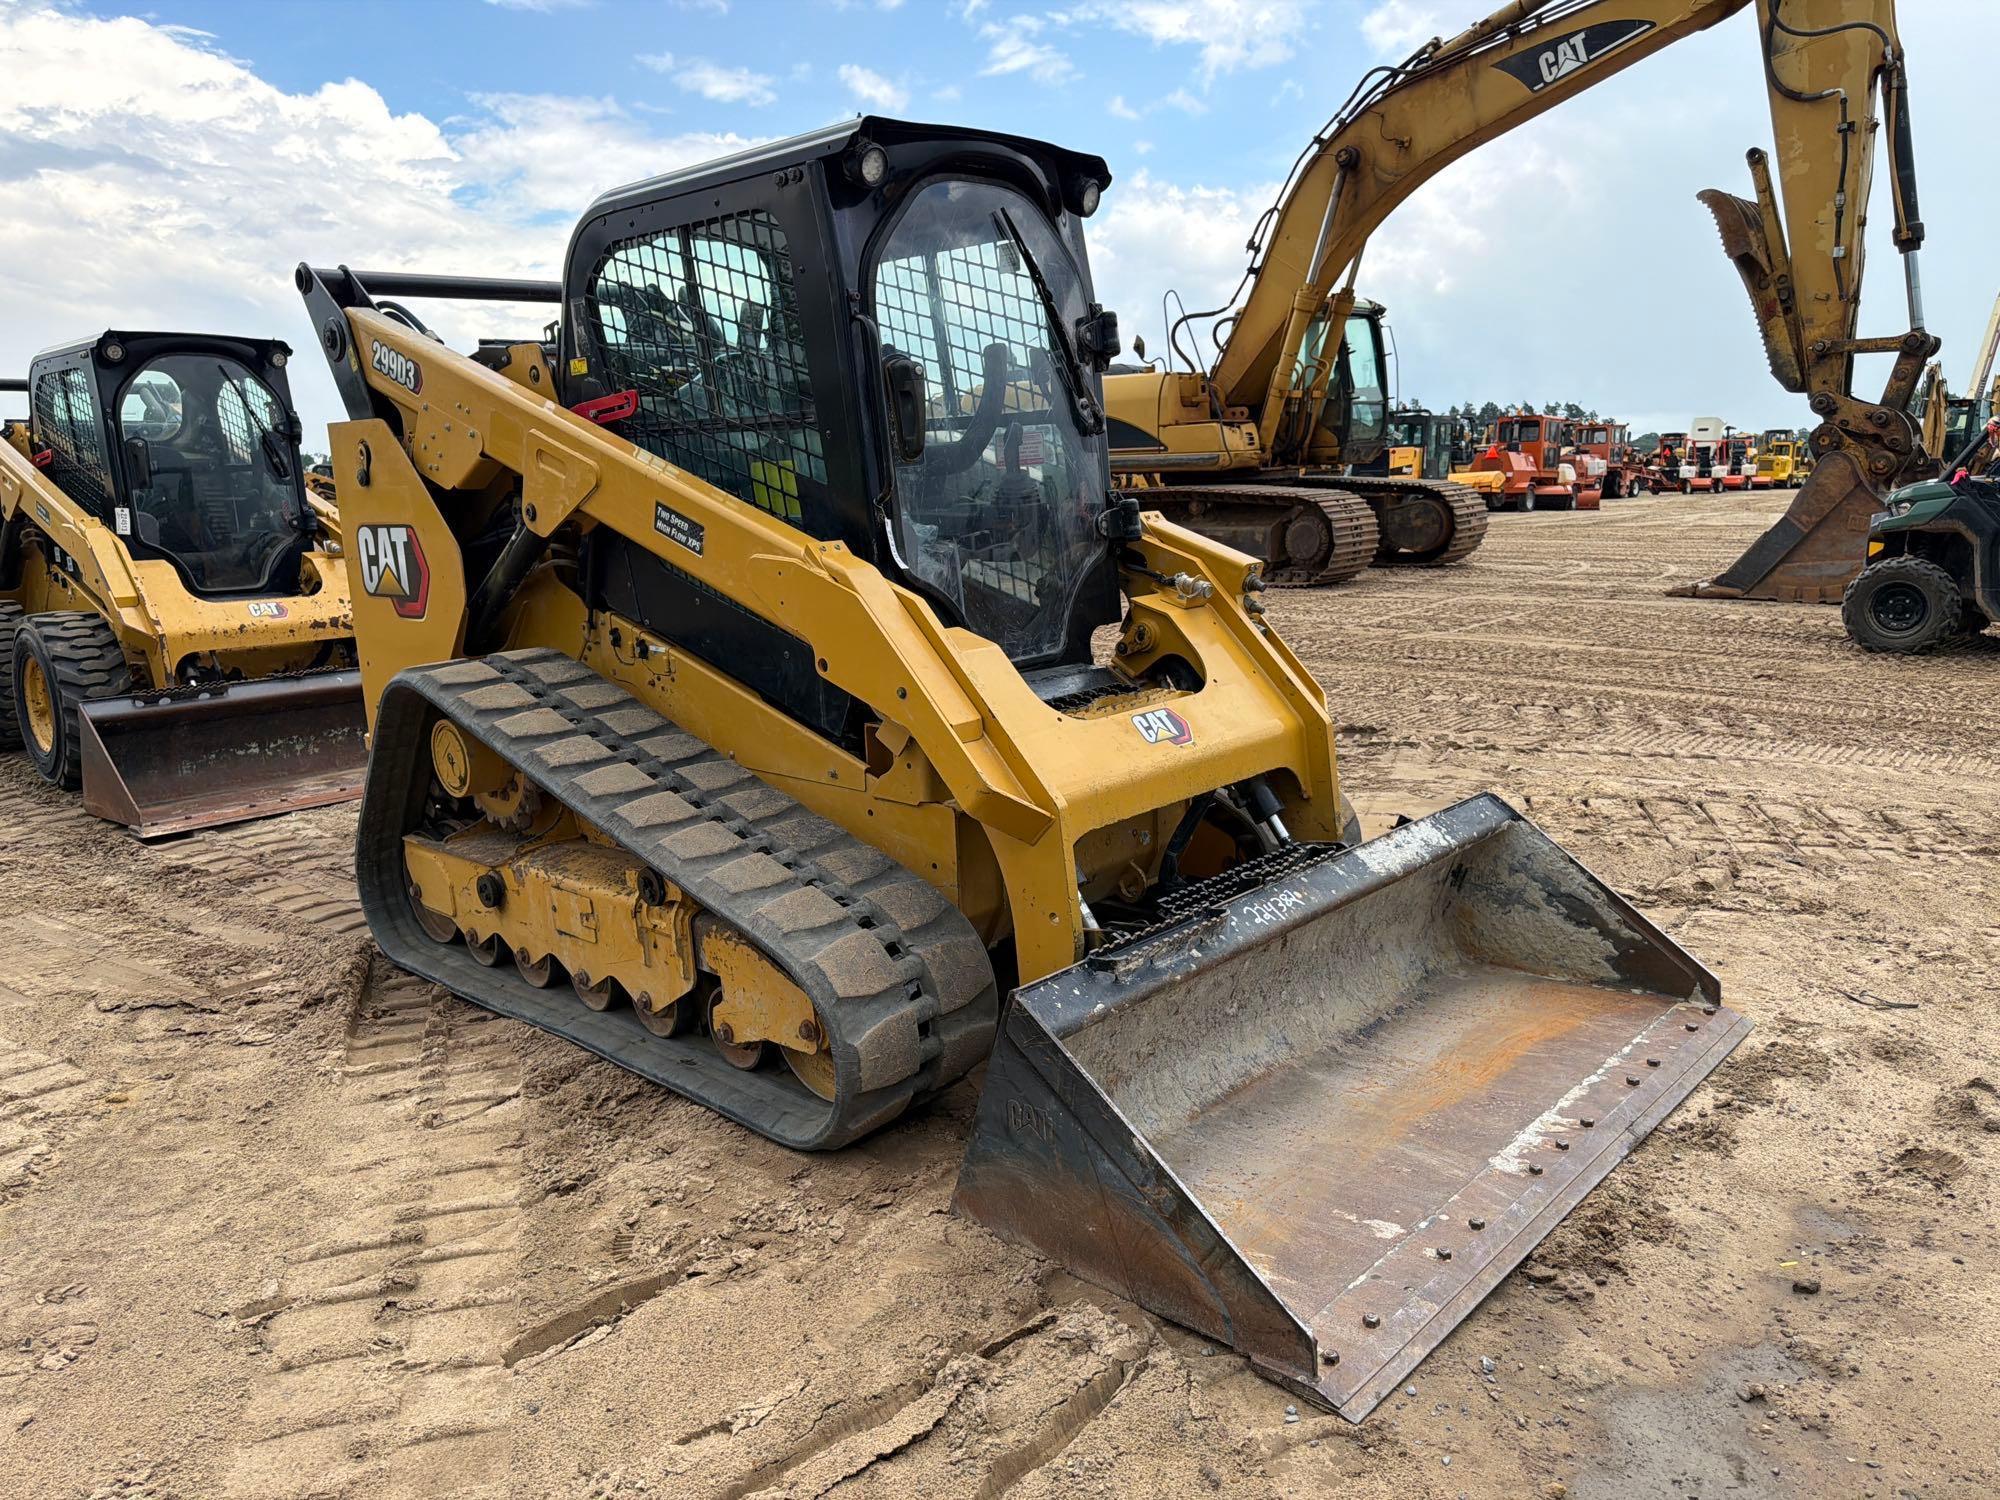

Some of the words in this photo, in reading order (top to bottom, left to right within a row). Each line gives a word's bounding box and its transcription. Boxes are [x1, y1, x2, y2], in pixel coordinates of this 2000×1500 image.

[1538, 32, 1589, 83] CAT
[372, 340, 415, 390] 299D3
[656, 519, 671, 534] HIGH
[671, 528, 687, 543] FLOW
[687, 537, 701, 551] XPS
[657, 506, 670, 521] TWO
[670, 514, 689, 531] SPEED
[358, 526, 410, 596] CAT
[248, 602, 279, 617] CAT
[1132, 709, 1180, 743] CAT
[1006, 1098, 1048, 1141] CAT
